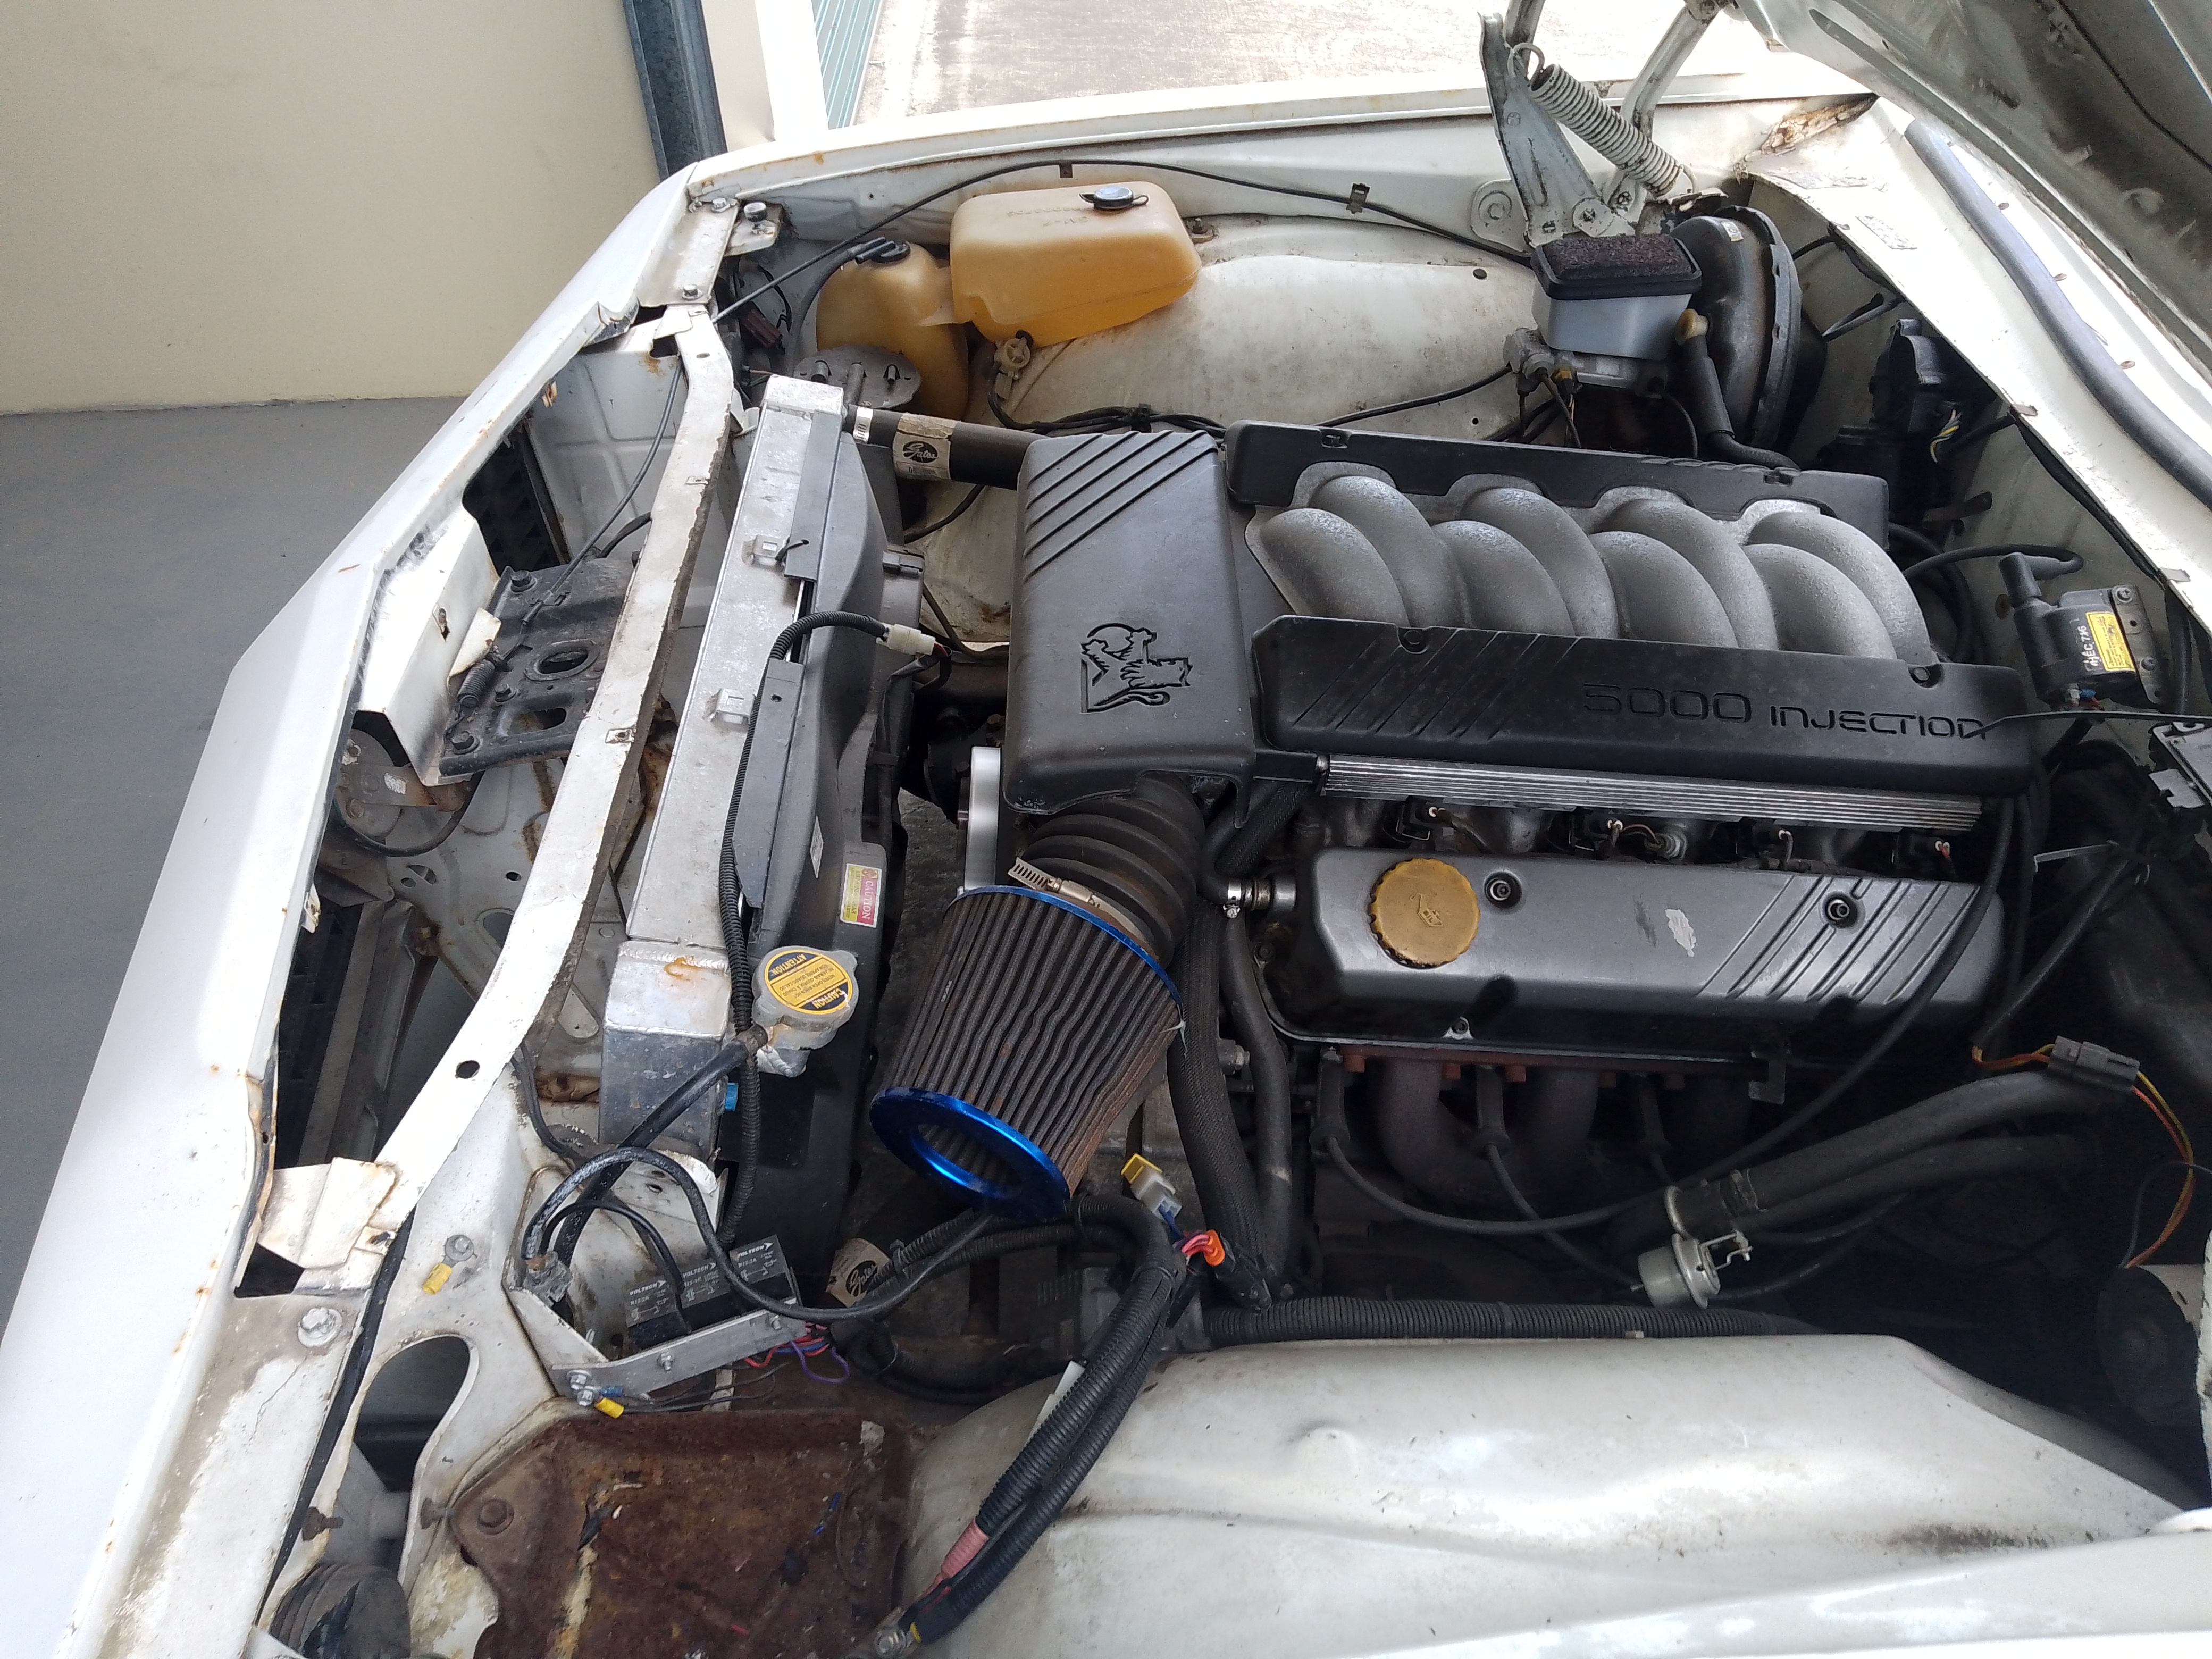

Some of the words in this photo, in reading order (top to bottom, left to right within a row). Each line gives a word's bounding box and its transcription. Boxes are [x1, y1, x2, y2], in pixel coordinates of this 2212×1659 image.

[903, 442, 938, 460] Gates
[1583, 683, 1752, 724] 5000
[1770, 705, 1987, 740] INJECTION
[861, 881, 874, 920] CAUTION
[1423, 909, 1434, 923] OIL
[772, 954, 806, 975] ATTENTION
[812, 988, 843, 1009] CAUTION
[737, 1244, 764, 1260] VOLTECH
[683, 1264, 709, 1278] VOLTECH
[630, 1282, 658, 1296] VOLTECH
